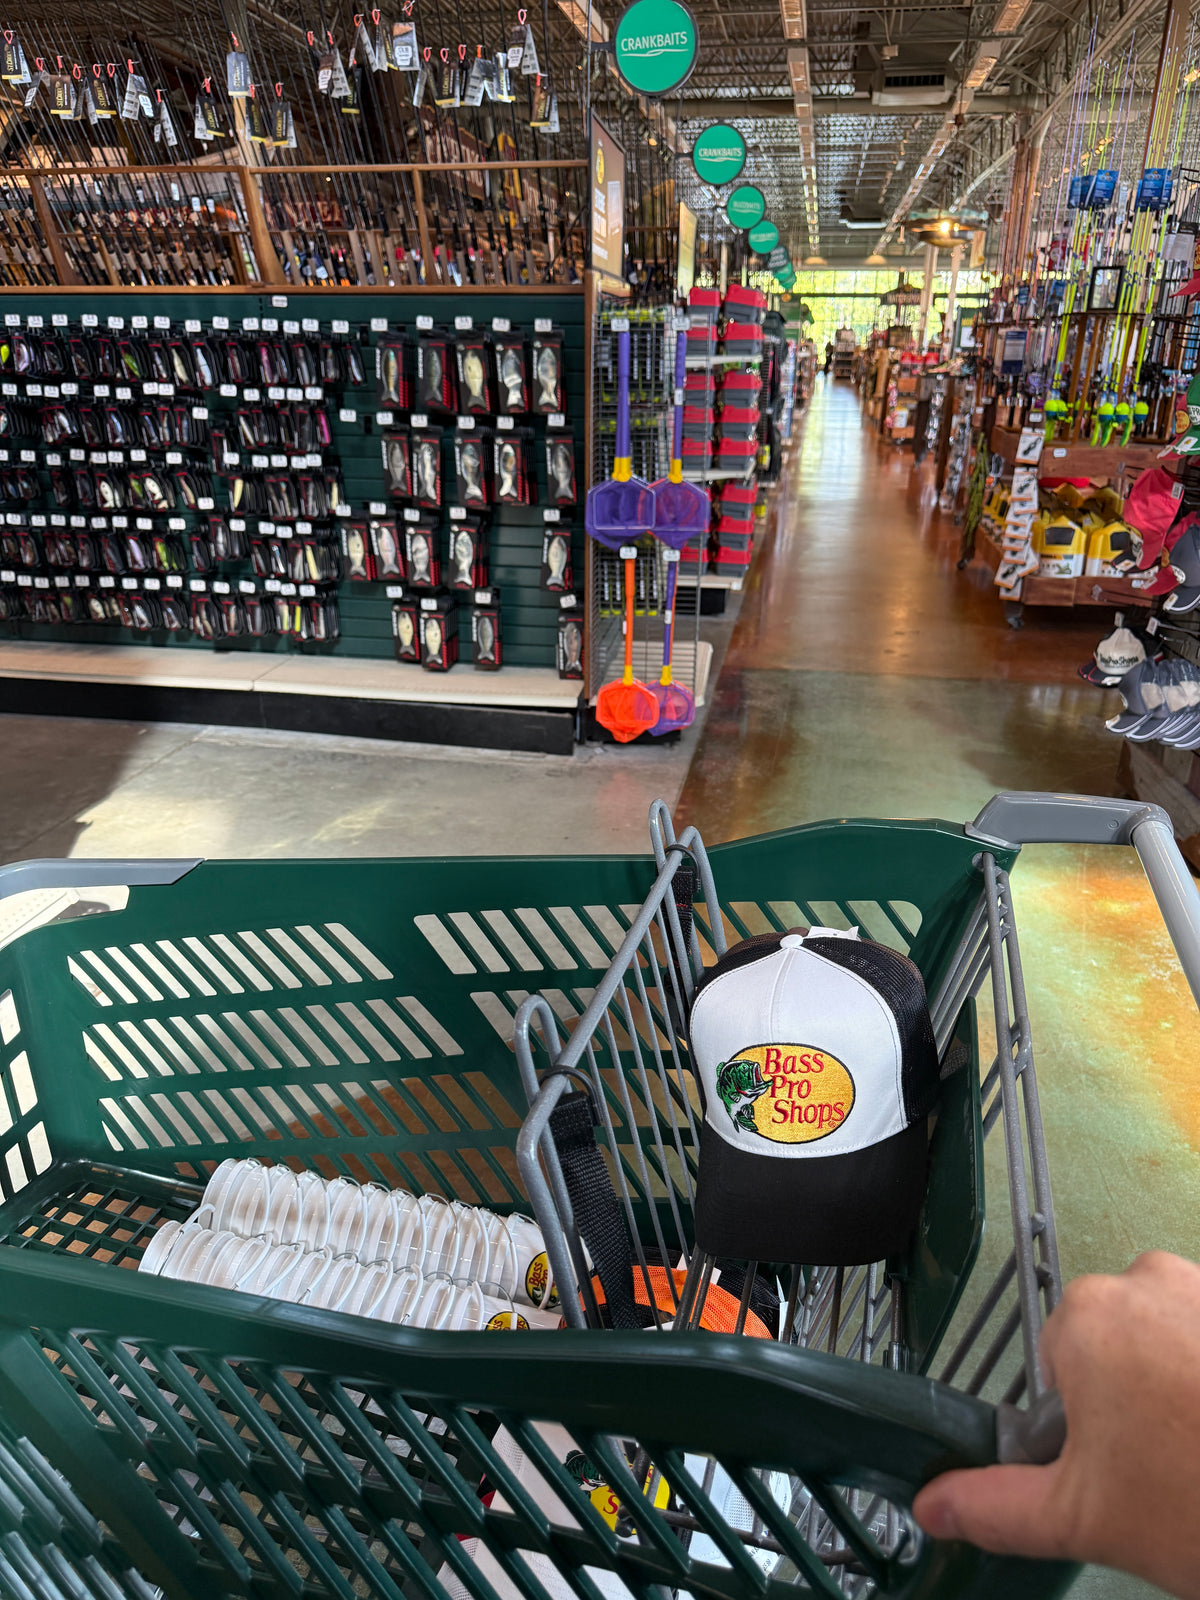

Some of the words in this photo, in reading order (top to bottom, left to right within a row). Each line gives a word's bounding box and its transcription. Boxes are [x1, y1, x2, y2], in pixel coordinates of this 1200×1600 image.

[621, 32, 688, 52] CRANKBAITS
[698, 147, 743, 158] CRANKBAITS
[763, 1048, 825, 1074] Bass
[770, 1075, 812, 1099] Pro
[771, 1100, 845, 1129] Shops
[529, 1262, 543, 1287] Bass
